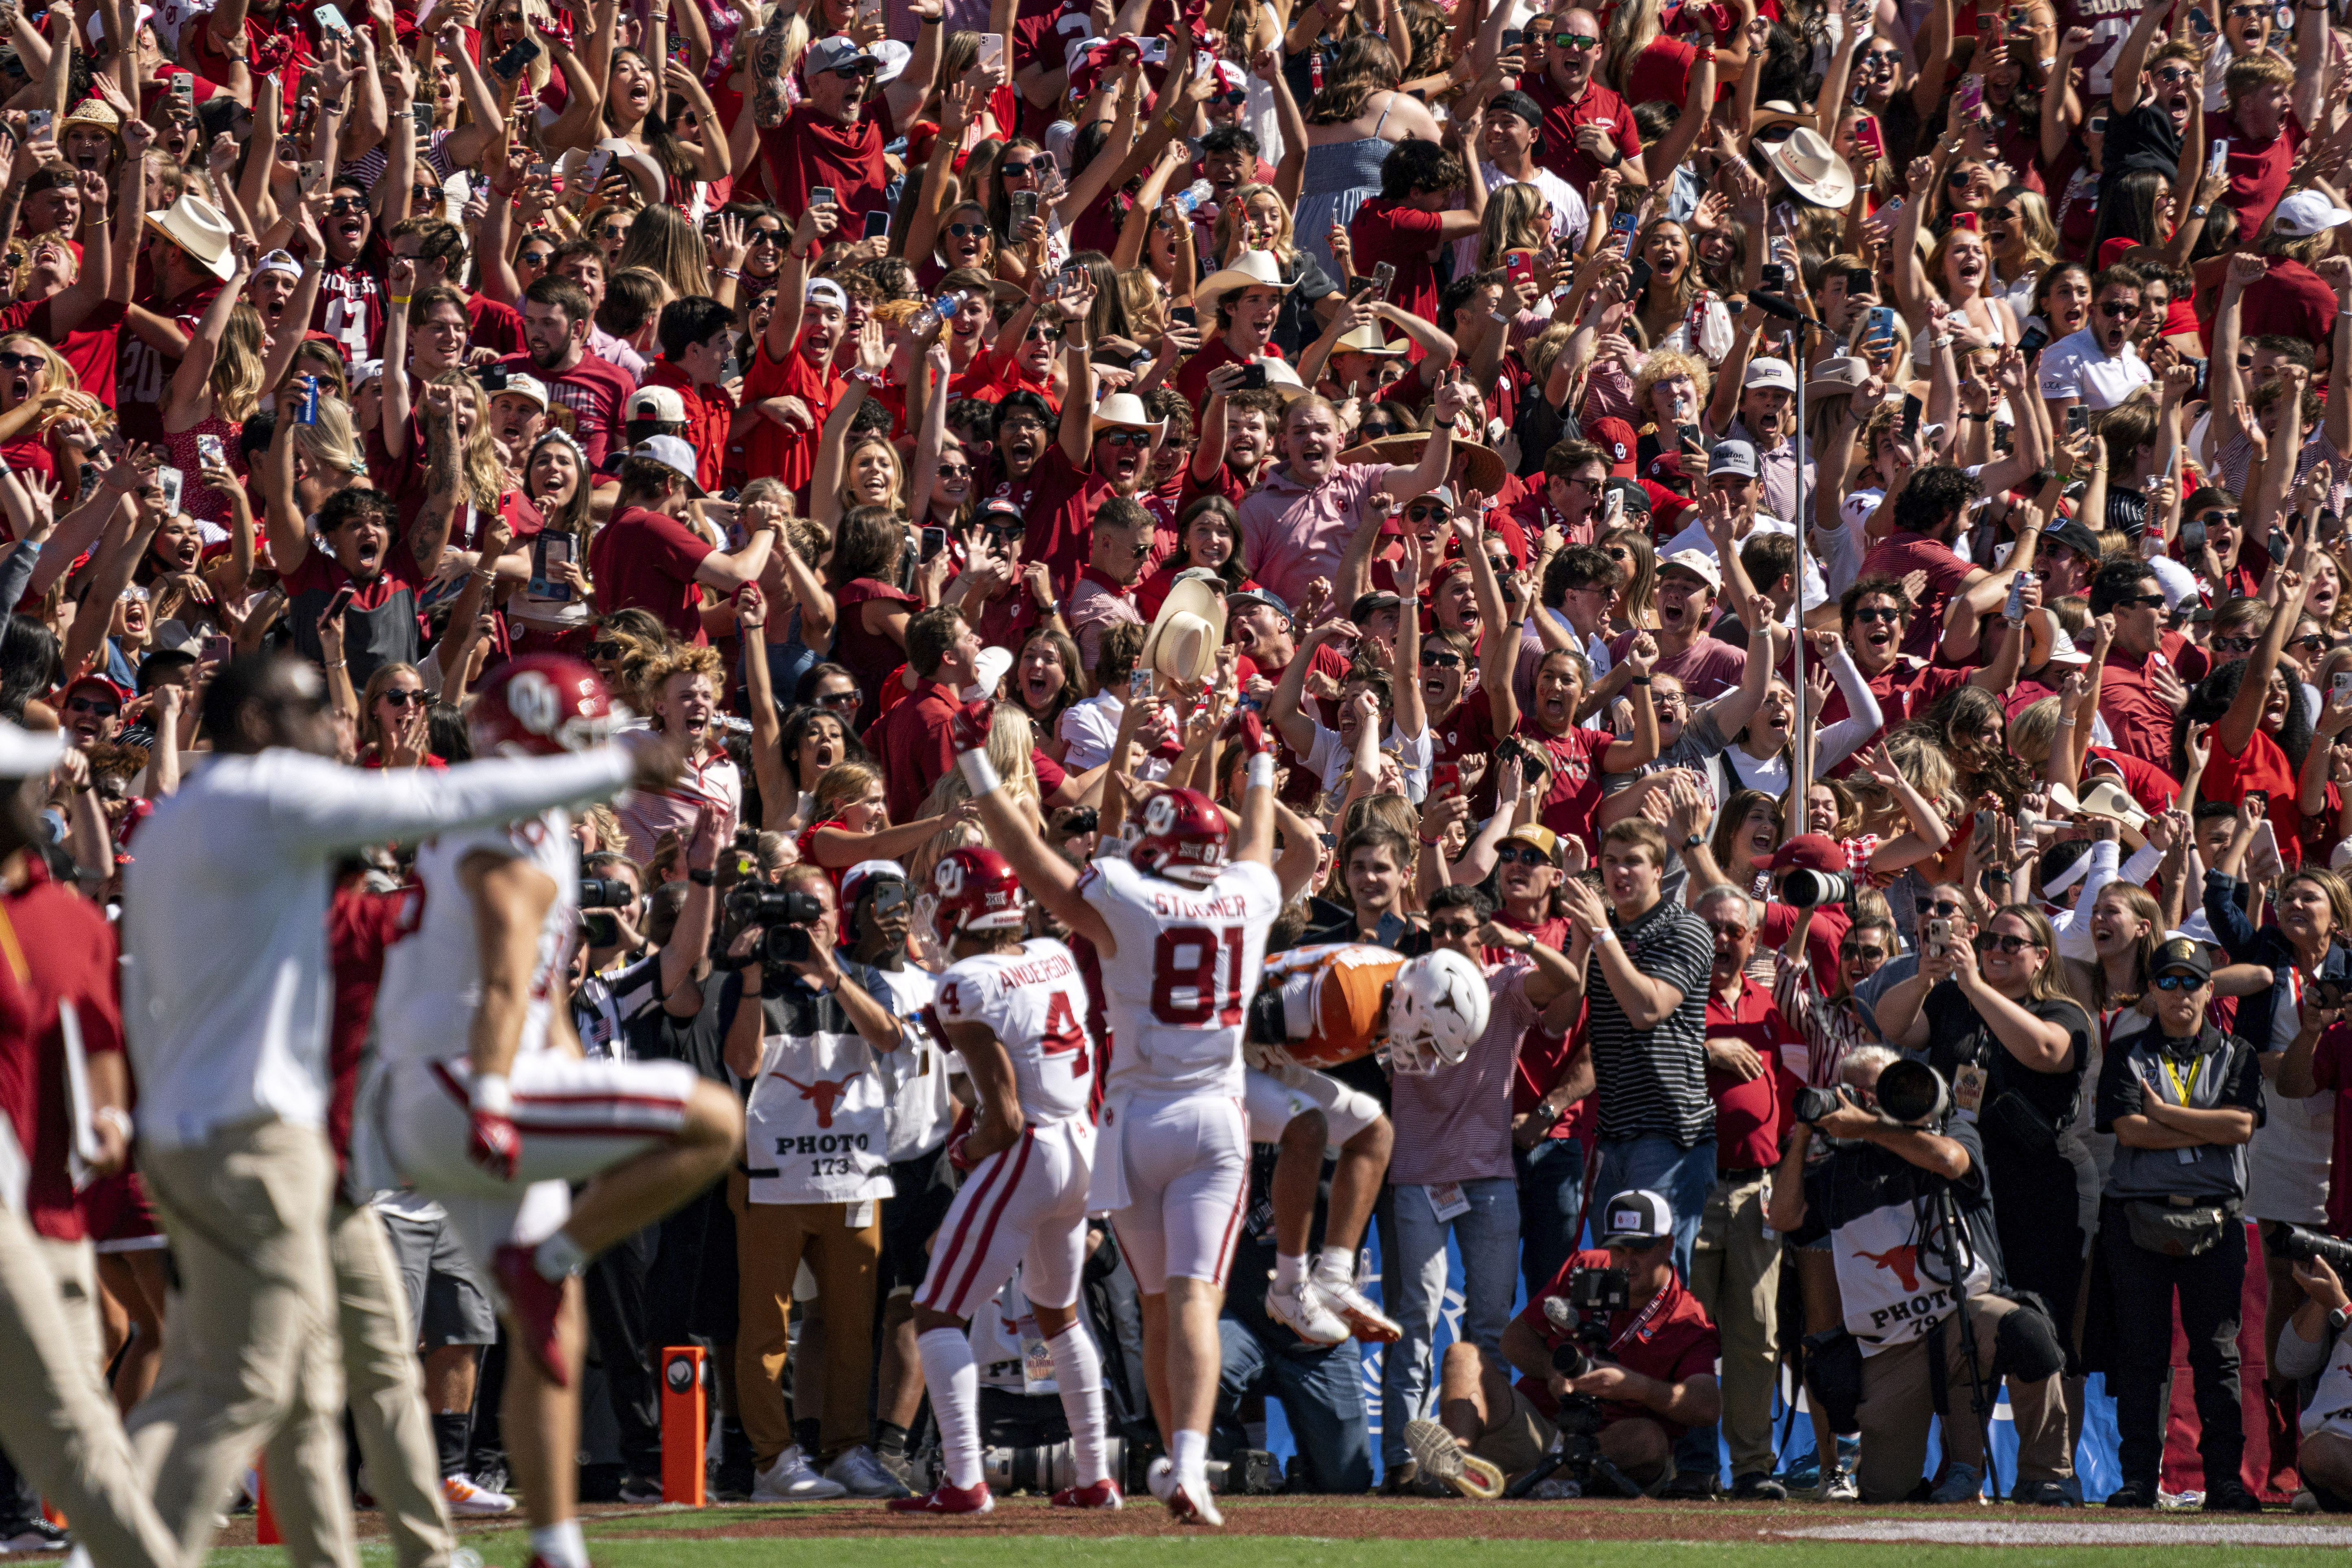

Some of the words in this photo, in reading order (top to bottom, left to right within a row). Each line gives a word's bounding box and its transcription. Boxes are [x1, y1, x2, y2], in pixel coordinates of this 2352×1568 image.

[1615, 443, 1626, 459] OU
[1652, 463, 1660, 475] OU
[1147, 795, 1176, 836] OU
[935, 858, 965, 896] OU
[1154, 894, 1247, 919] STOGNER
[999, 953, 1075, 993] ANDERSON
[1152, 927, 1244, 1025] 81
[940, 982, 960, 1015] 4
[1042, 990, 1089, 1079] 4
[775, 1134, 868, 1155] PHOTO
[811, 1158, 849, 1177] 173
[1909, 1316, 1940, 1336] 79
